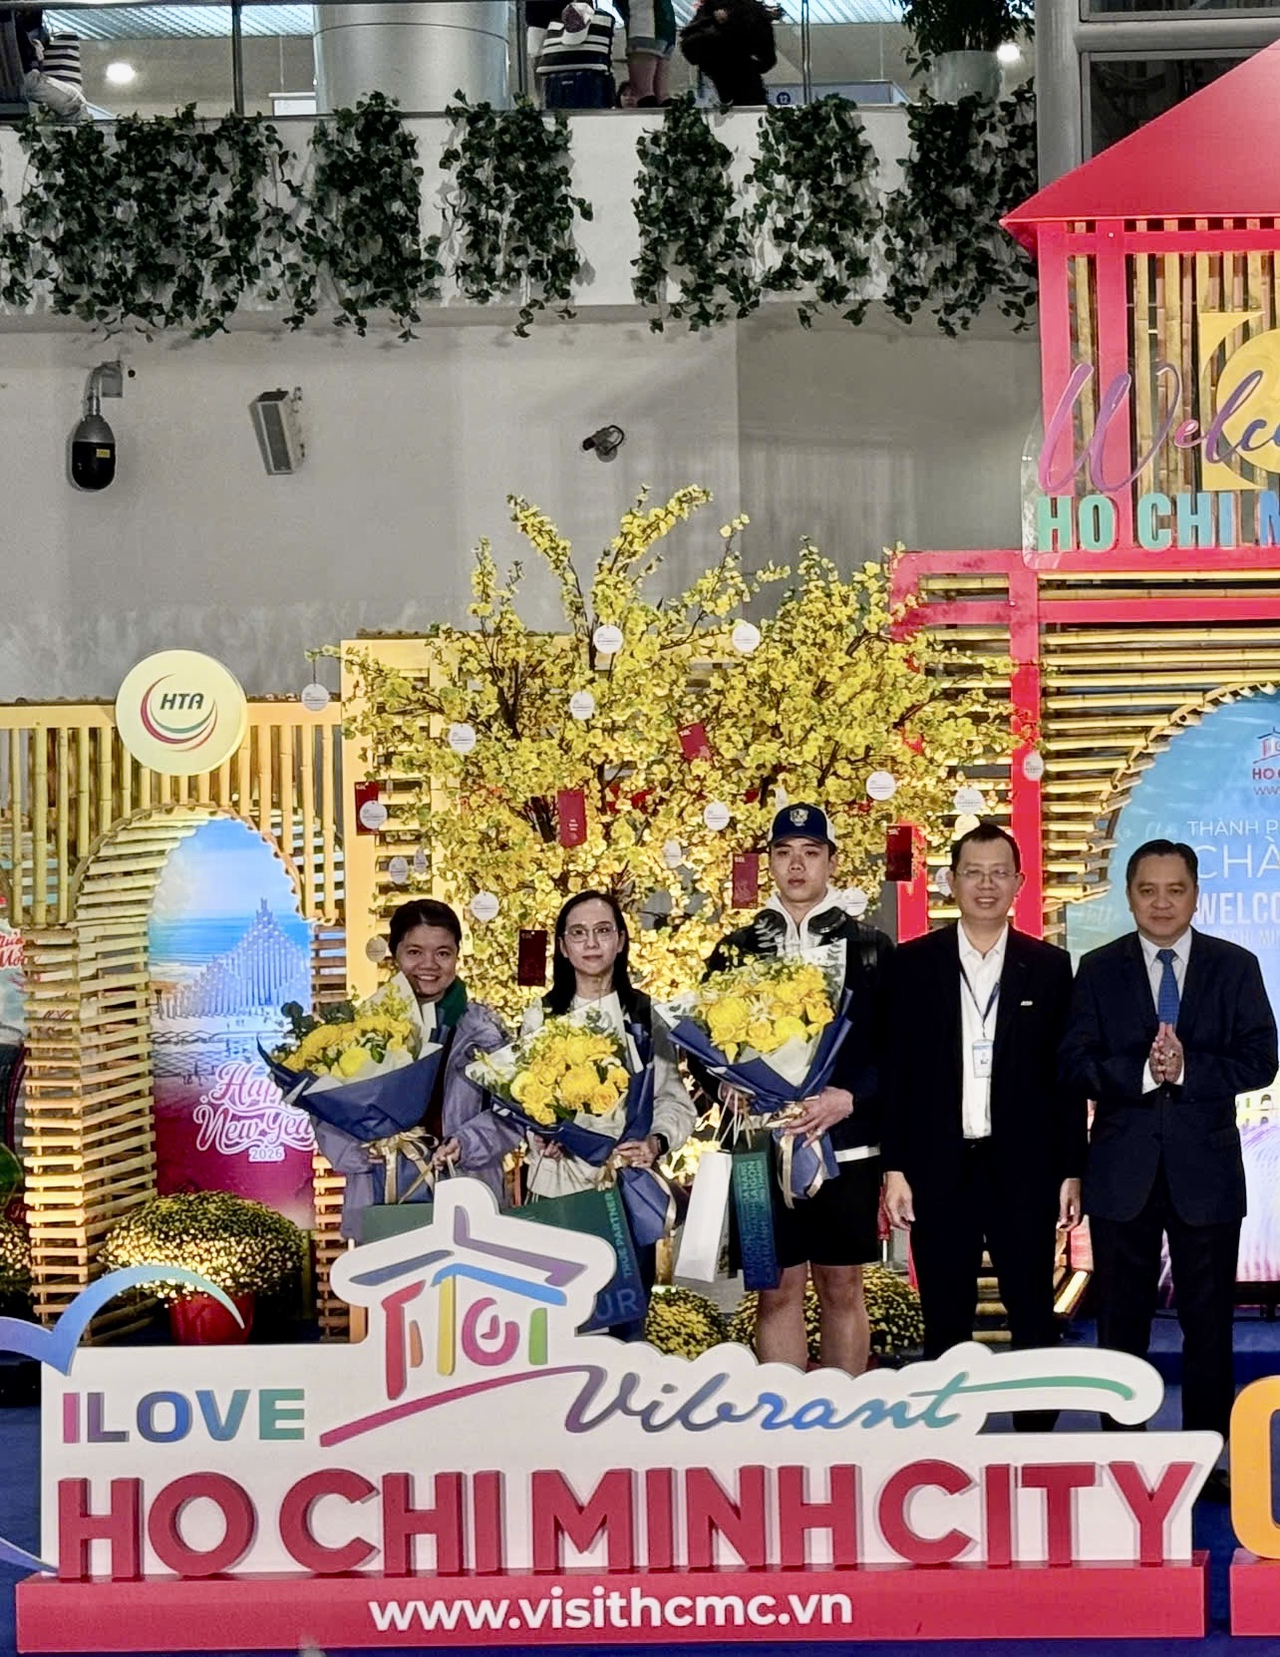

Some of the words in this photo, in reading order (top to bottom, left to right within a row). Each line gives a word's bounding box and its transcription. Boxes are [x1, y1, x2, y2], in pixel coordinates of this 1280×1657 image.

[1038, 494, 1115, 552] HO
[1139, 492, 1236, 549] CHI
[159, 692, 204, 710] HTA
[1252, 767, 1275, 780] HO
[1187, 818, 1259, 836] THÀNH
[208, 1060, 284, 1109] Hap
[263, 1111, 316, 1149] Yea
[250, 1147, 284, 1161] 2026
[604, 1191, 624, 1246] PARTNER
[565, 1364, 1134, 1434] Vibrant
[58, 1469, 257, 1582] HO
[279, 1467, 506, 1577] CHI
[531, 1463, 862, 1576] MINH
[878, 1459, 1197, 1568] CITY
[367, 1586, 853, 1632] www.visithcmc.vn
